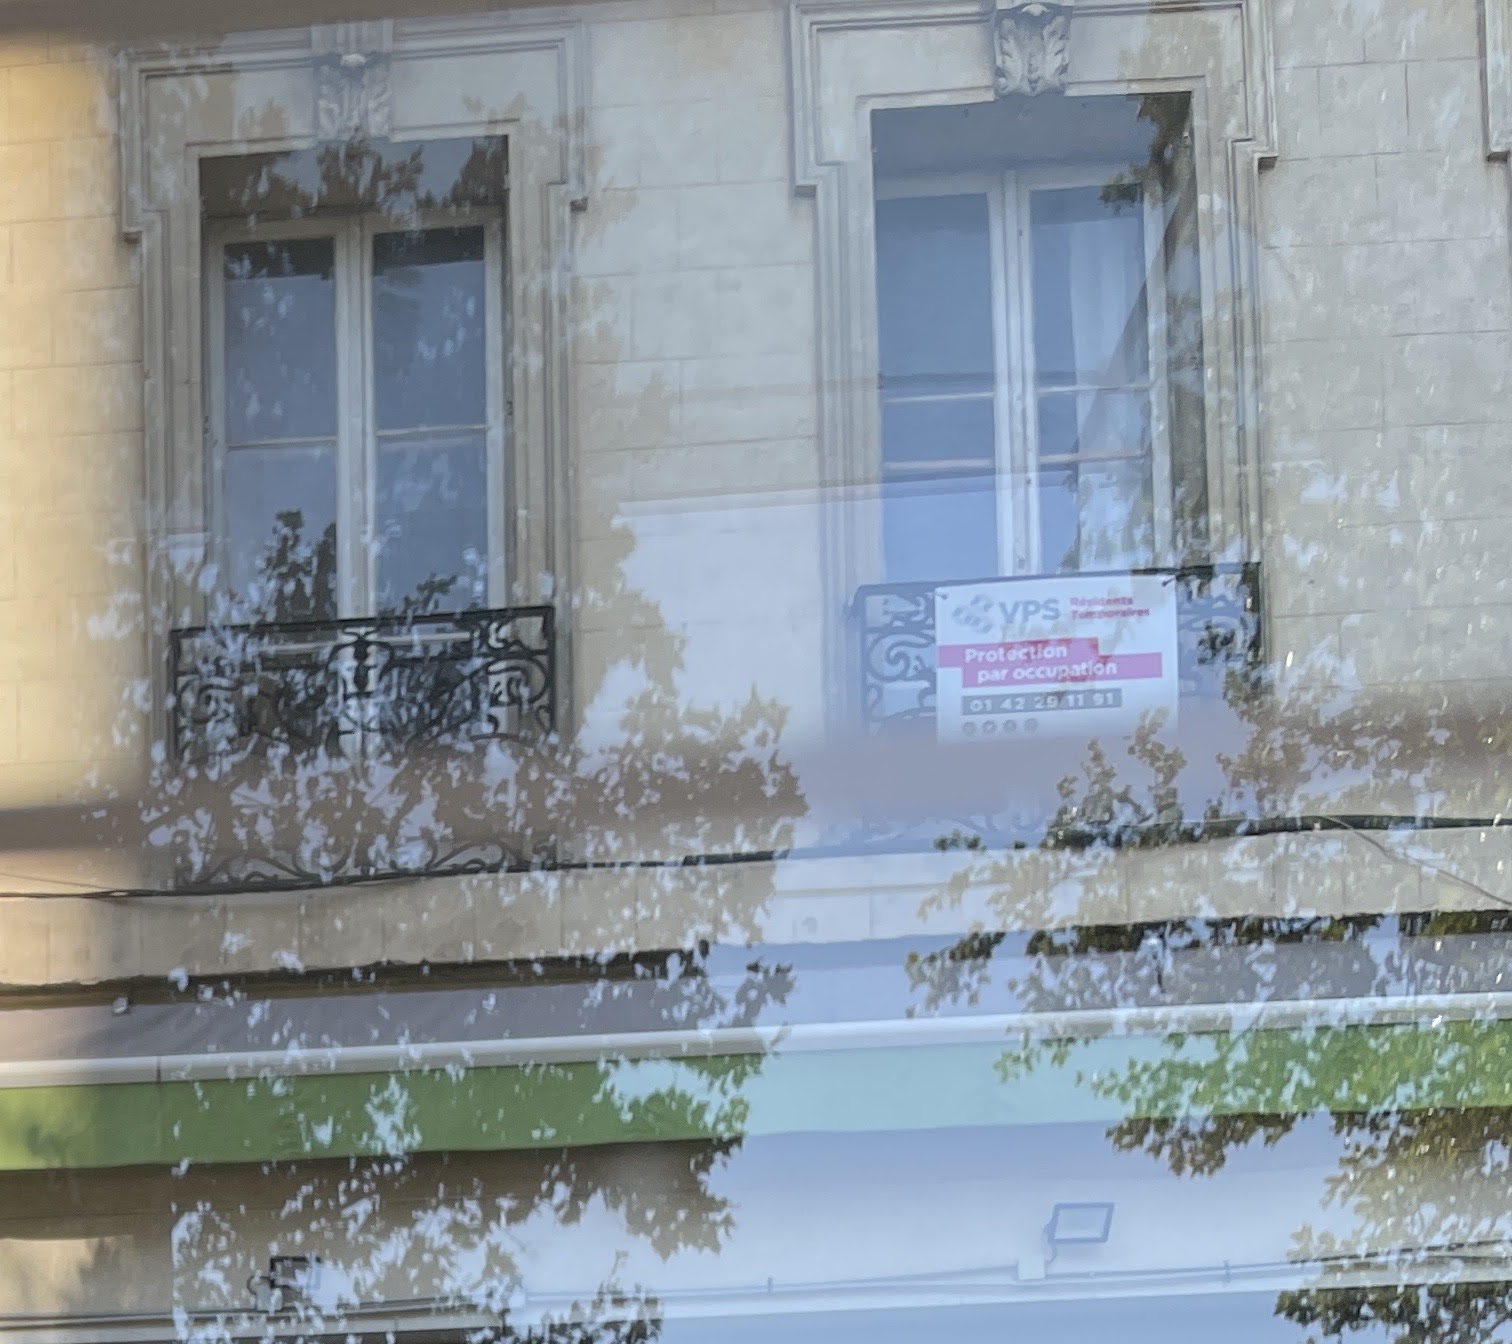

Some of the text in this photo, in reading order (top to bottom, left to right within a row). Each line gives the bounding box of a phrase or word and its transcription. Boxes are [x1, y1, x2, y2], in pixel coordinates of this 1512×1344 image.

[1000, 598, 1061, 623] VPS
[964, 644, 1068, 664] Protection
[977, 660, 1118, 684] par occupation
[969, 698, 993, 713] 01
[999, 696, 1026, 712] 42
[1067, 694, 1085, 708] 11
[1091, 691, 1115, 706] 91
